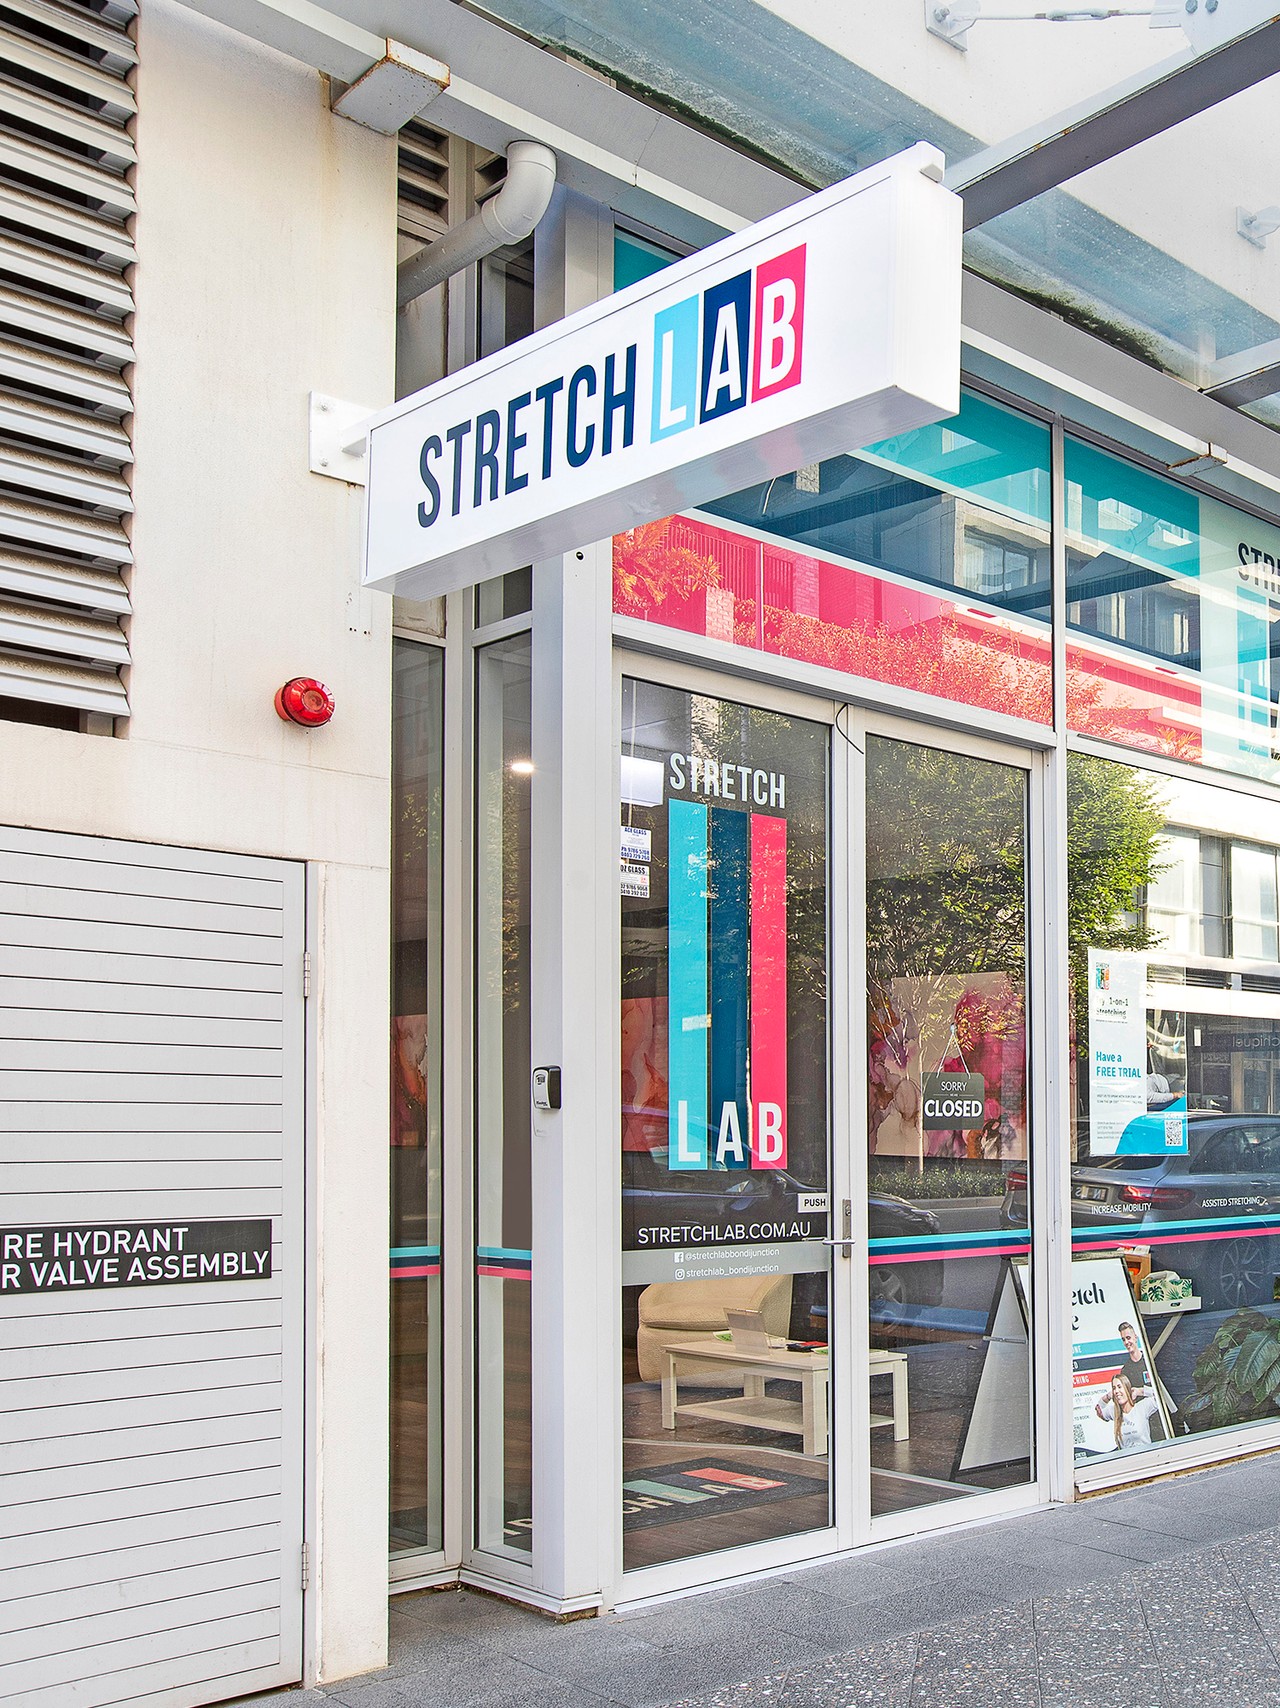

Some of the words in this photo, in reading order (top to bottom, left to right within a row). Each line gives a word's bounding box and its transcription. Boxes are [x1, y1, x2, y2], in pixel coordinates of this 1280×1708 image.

[417, 343, 637, 528] STRETCH
[658, 277, 796, 431] LAB
[669, 752, 785, 809] STRETCH
[633, 828, 647, 836] GLASS
[628, 866, 646, 875] GLASS
[1096, 1051, 1116, 1063] Have
[1116, 1055, 1122, 1063] a
[1096, 1066, 1117, 1078] FREE
[1118, 1067, 1142, 1079] TRIAL
[941, 1081, 967, 1091] SORRY
[924, 1099, 983, 1118] CLOSED
[676, 1100, 784, 1162] LAB
[804, 1198, 826, 1207] PUSH
[1091, 1204, 1122, 1214] INCREASE
[1122, 1202, 1152, 1213] MOBILITY
[1202, 1199, 1228, 1208] ASSISTED
[1228, 1196, 1260, 1206] STRETCHING
[638, 1221, 812, 1244] STRETCHLAB.COM.AU
[3, 1233, 43, 1259] RE
[54, 1227, 189, 1258] HYDRANT
[685, 1247, 780, 1262] @stretchlabbondijunction
[1, 1263, 21, 1289] R
[30, 1258, 120, 1287] VALVE
[127, 1250, 270, 1281] ASSEMBLY
[686, 1264, 779, 1278] stretchlab_bondijunction
